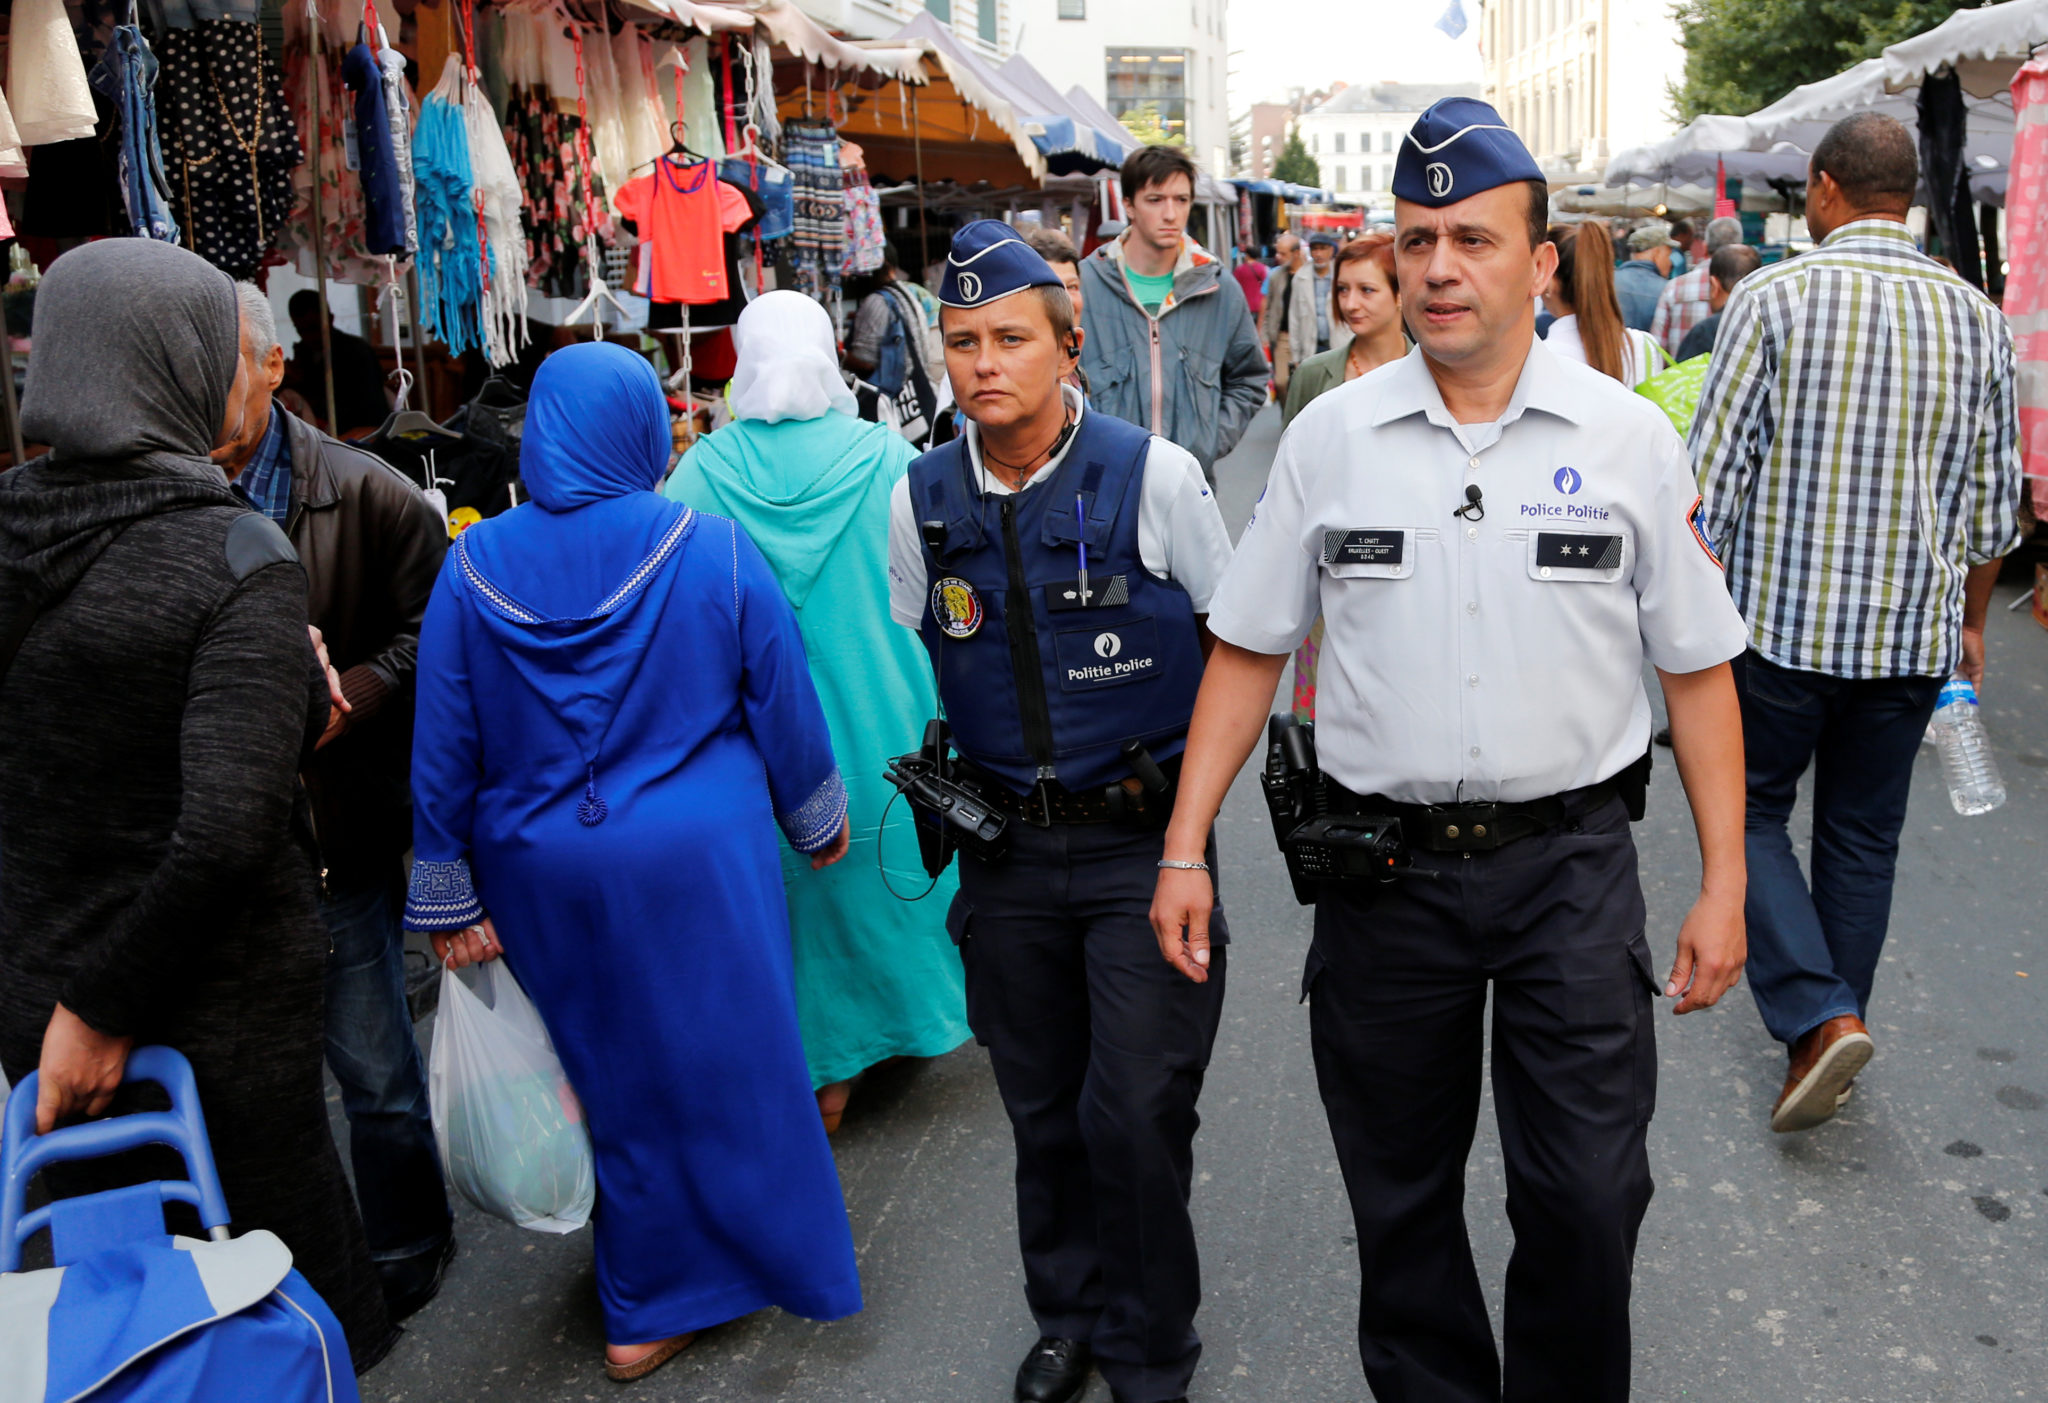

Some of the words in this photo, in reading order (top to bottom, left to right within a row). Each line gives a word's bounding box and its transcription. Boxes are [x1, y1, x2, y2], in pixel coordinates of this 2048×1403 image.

[1520, 503, 1562, 516] Police
[1567, 504, 1609, 520] Politie
[1068, 665, 1112, 681] Politie
[1114, 657, 1153, 674] Police
